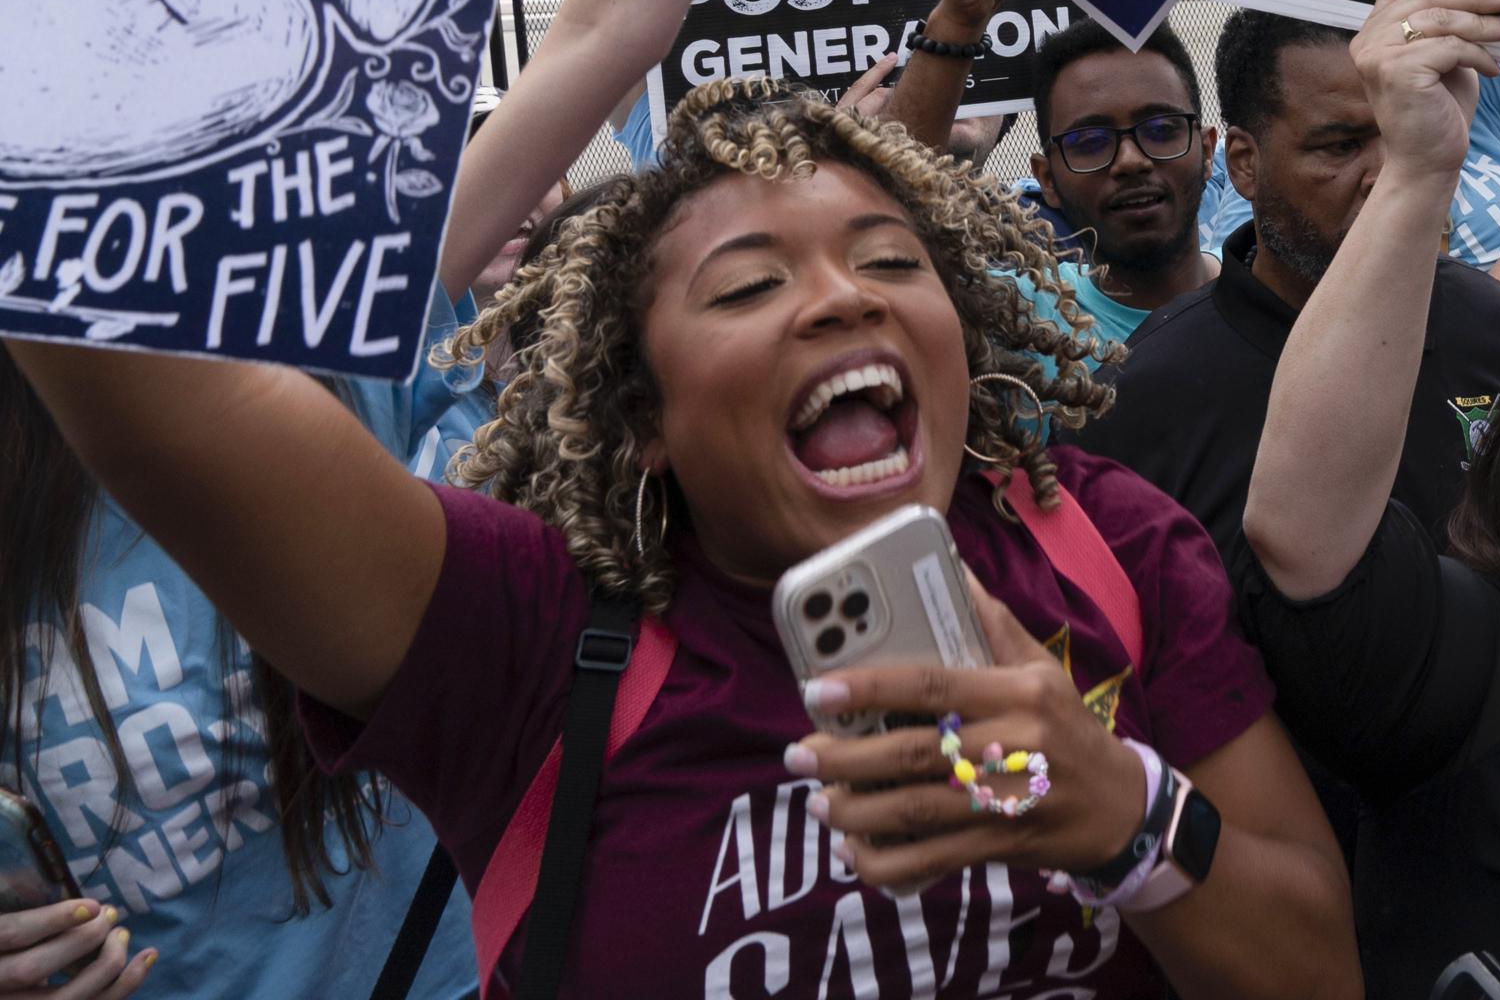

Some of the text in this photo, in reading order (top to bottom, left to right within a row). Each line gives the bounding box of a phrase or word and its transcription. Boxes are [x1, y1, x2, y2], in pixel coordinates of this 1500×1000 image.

[33, 193, 204, 294] FOR
[227, 138, 356, 229] THE
[206, 232, 411, 356] FIVE
